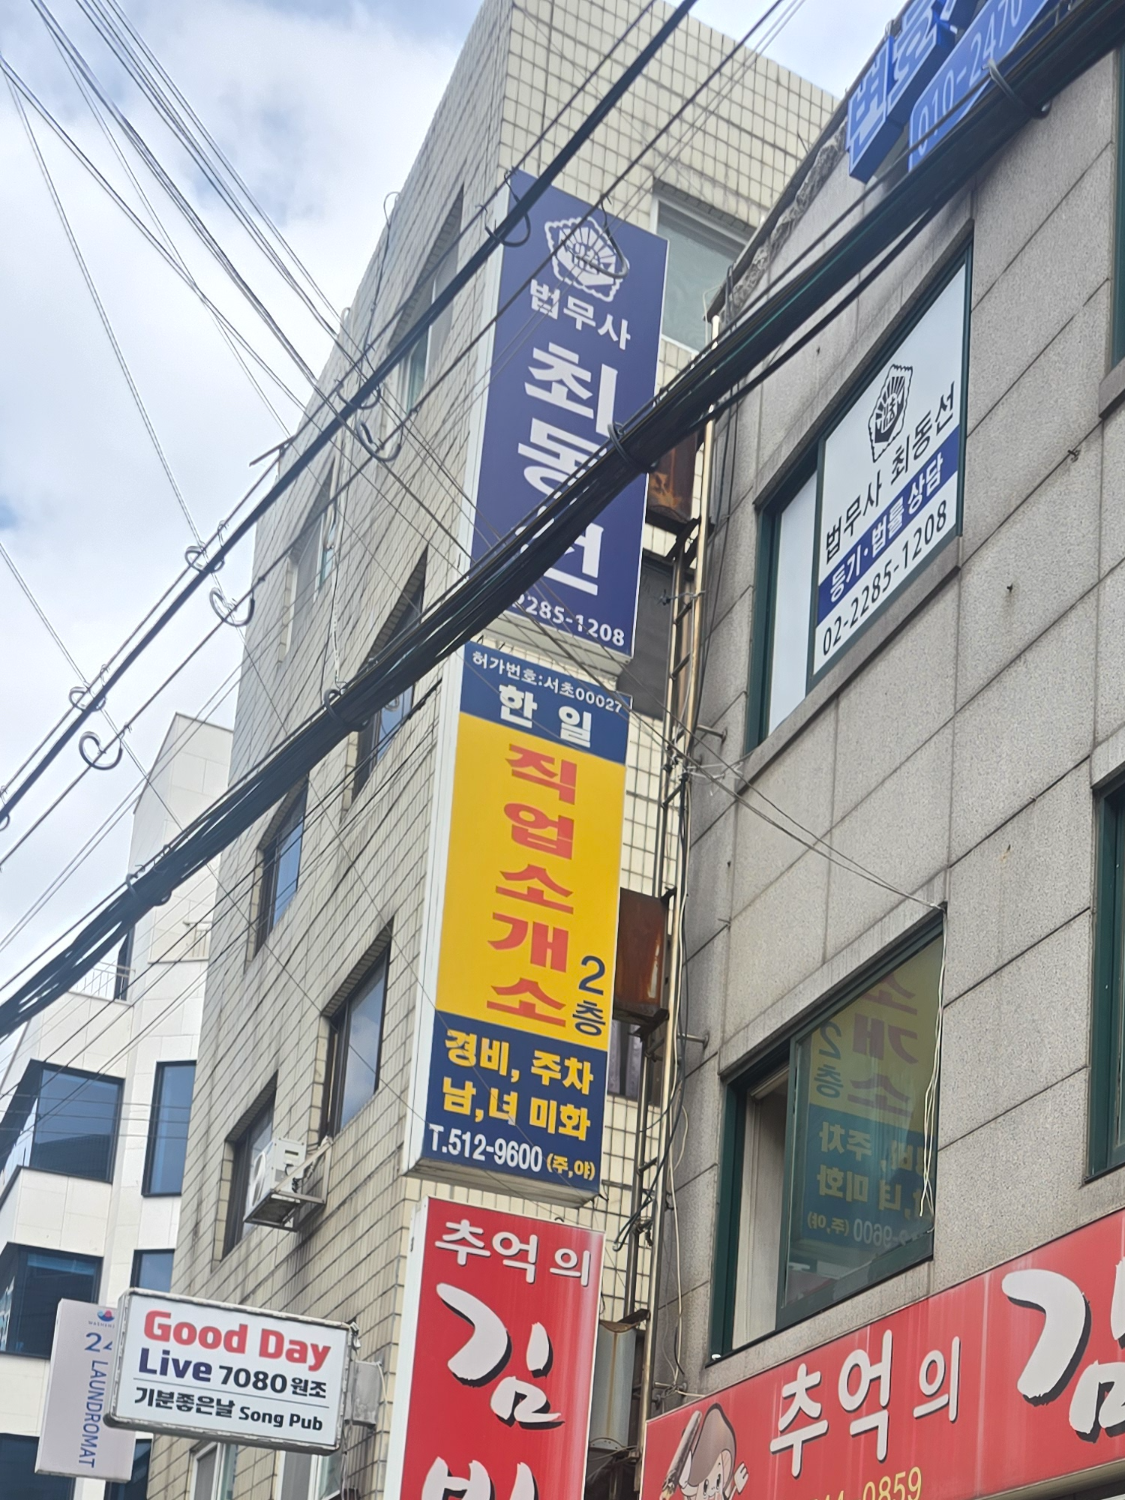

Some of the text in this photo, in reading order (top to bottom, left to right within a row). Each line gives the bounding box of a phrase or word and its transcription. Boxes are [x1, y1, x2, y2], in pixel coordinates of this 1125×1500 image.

[847, 0, 957, 175] 변호
[529, 278, 632, 352] 법무사
[824, 380, 955, 566] 법무사 최동선
[906, 451, 944, 517] 상담
[821, 498, 948, 657] 02-2285-1208
[486, 742, 579, 1031] 직업소개소
[530, 1048, 595, 1097] 주차
[428, 1122, 543, 1173] T.512-9600
[529, 1099, 591, 1142] 미화
[138, 1347, 327, 1399] Live 7080 원조
[144, 1310, 331, 1372] Good Day
[78, 1360, 108, 1468] LAUNDROMAT
[239, 1406, 284, 1428] Song
[289, 1414, 323, 1431] Pub
